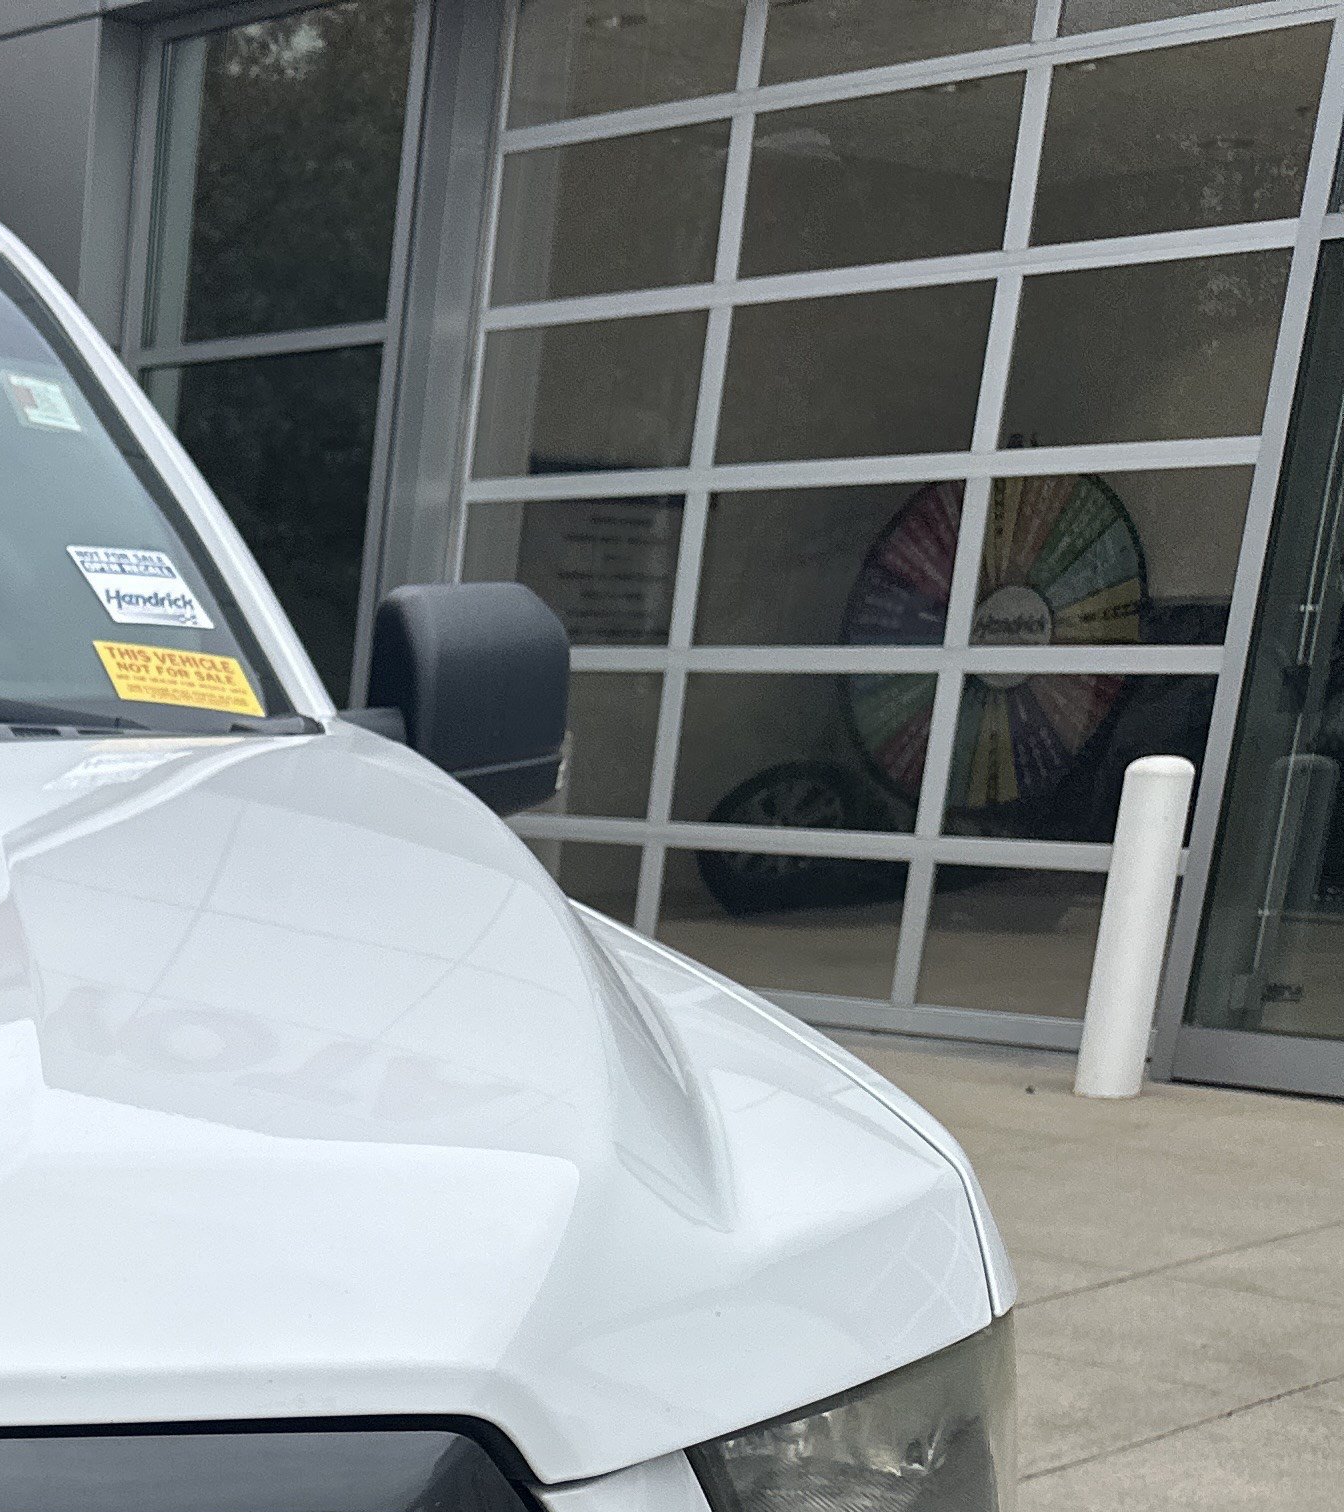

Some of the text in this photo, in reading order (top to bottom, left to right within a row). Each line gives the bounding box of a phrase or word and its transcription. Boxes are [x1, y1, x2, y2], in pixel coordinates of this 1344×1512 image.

[104, 646, 233, 673] THIS VEHICLE
[117, 662, 150, 674] NOT
[156, 666, 190, 679] FOR
[194, 671, 234, 685] SALE
